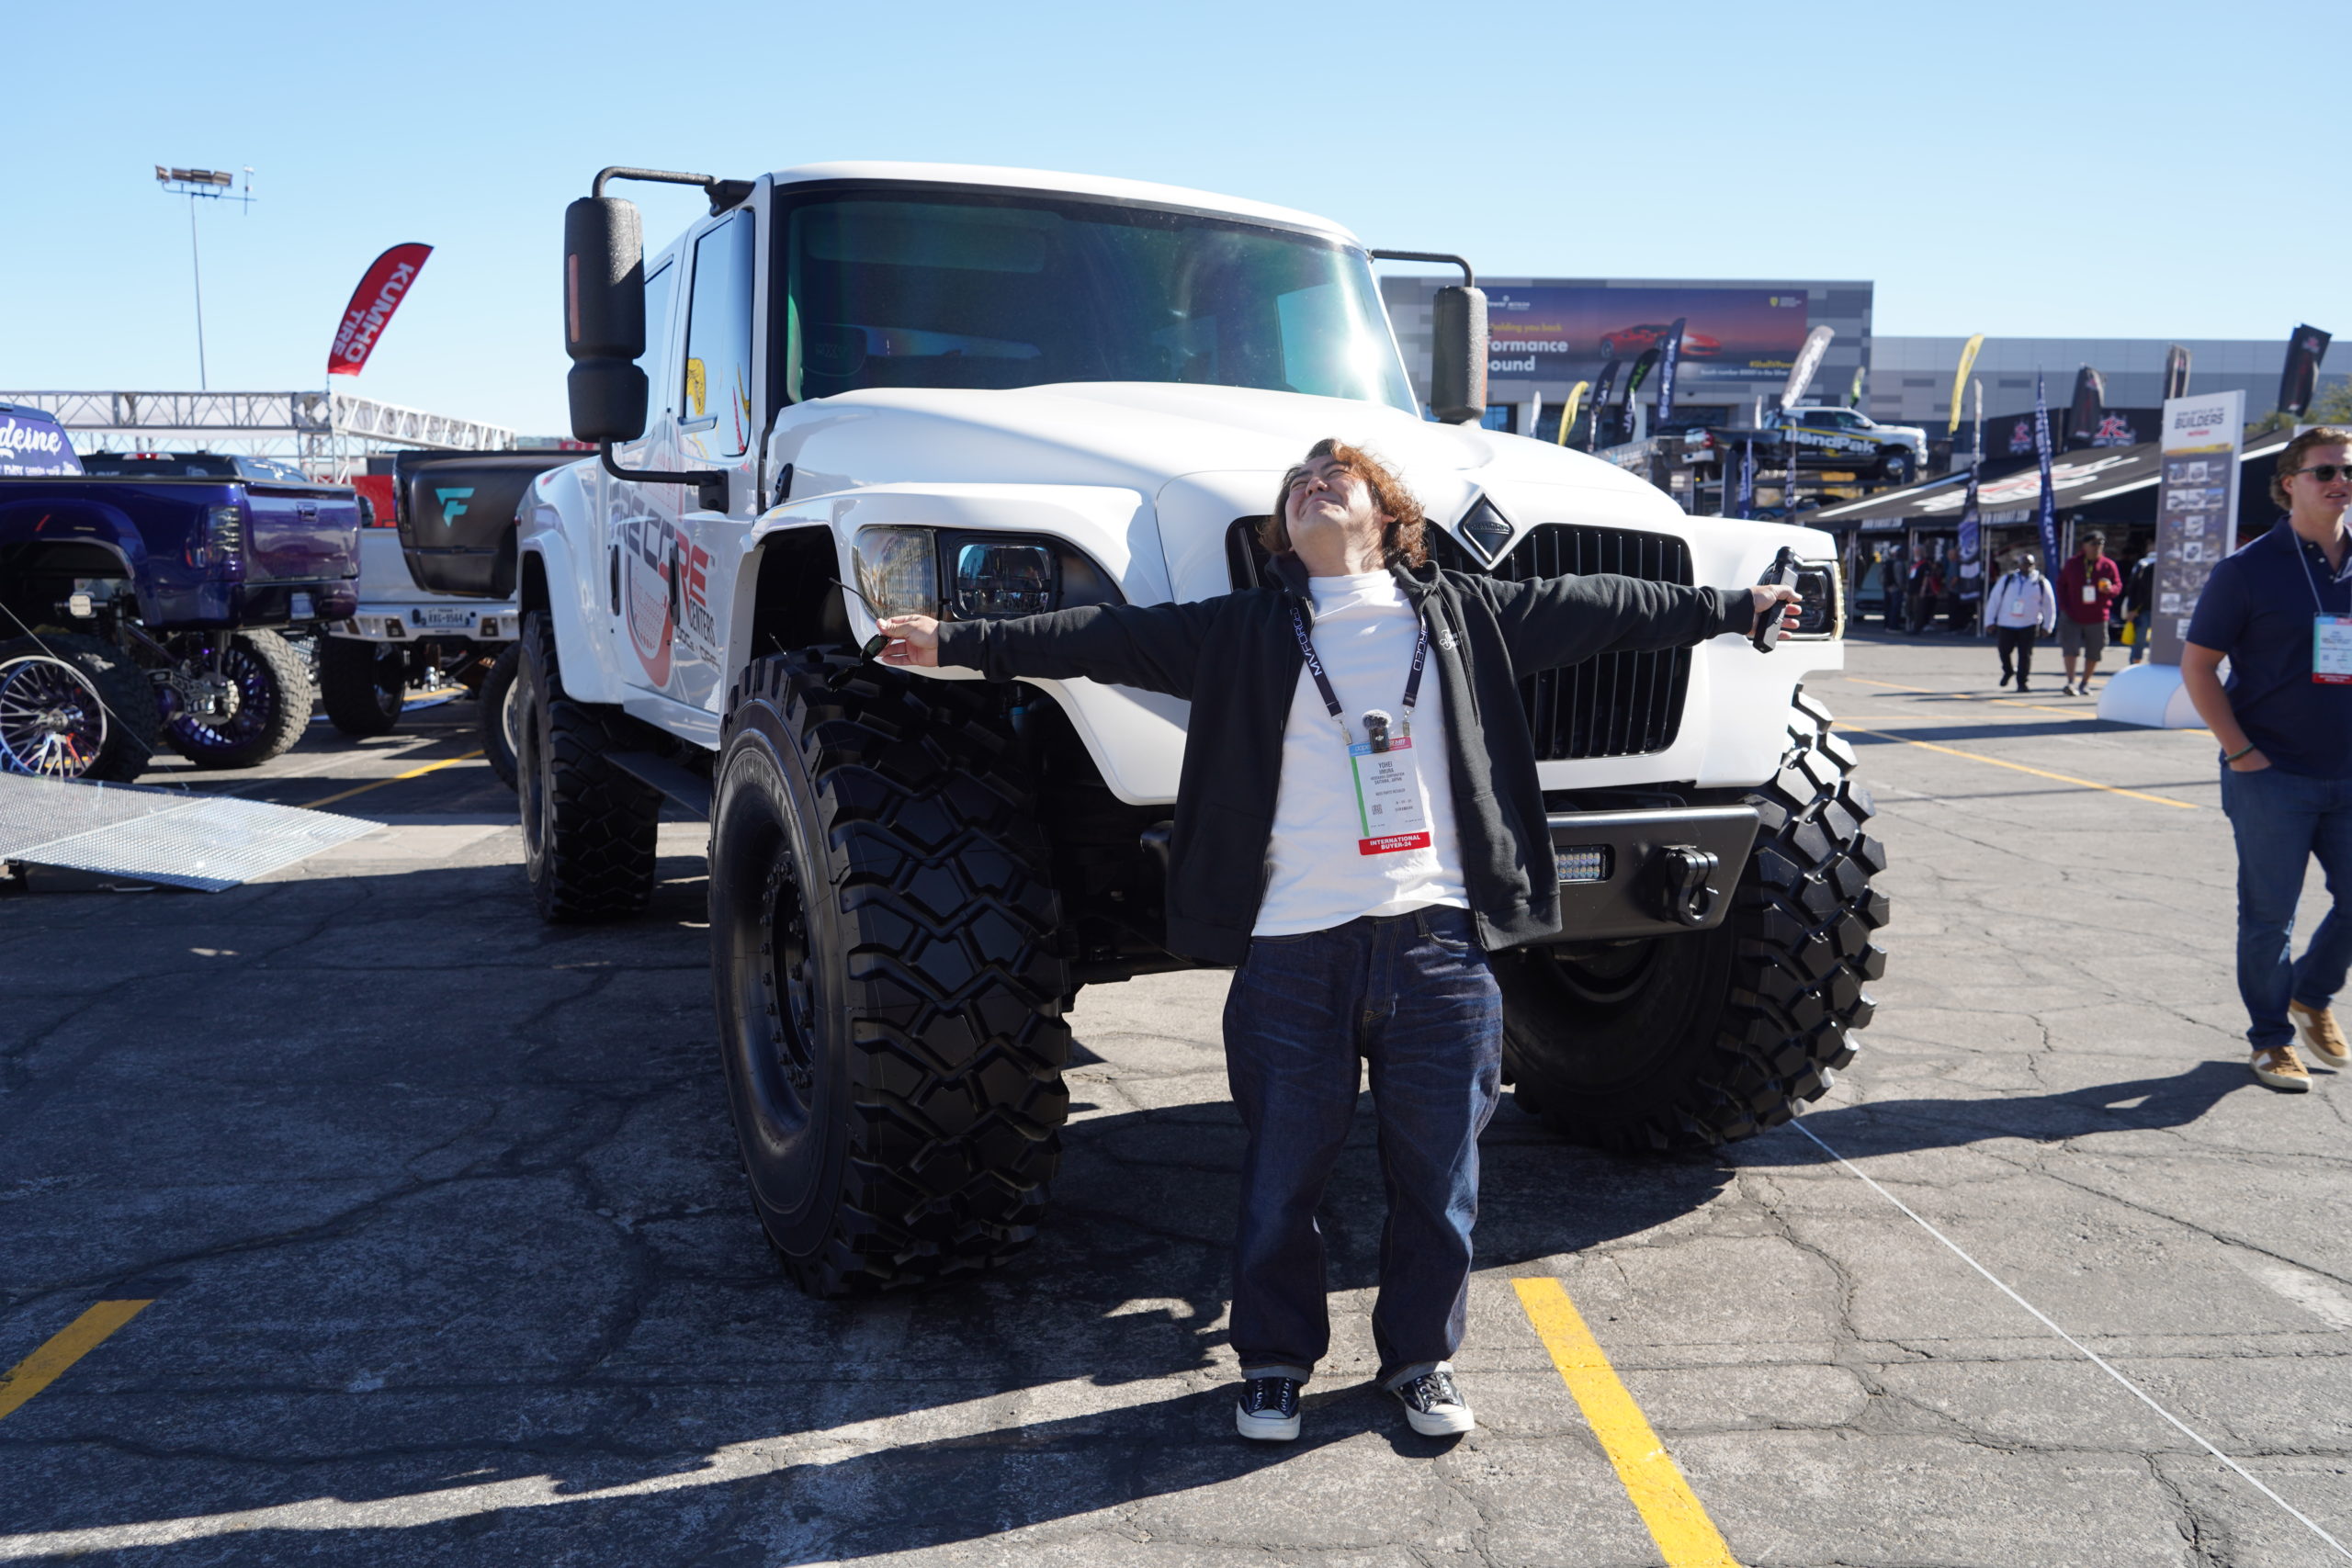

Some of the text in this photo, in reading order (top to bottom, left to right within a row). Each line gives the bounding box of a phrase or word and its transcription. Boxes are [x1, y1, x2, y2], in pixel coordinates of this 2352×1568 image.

[345, 262, 414, 363] KUMHO
[333, 310, 367, 356] TIRE
[1487, 355, 1535, 371] ound
[2175, 412, 2224, 429] BUILDERS
[1785, 428, 1876, 453] BendPak
[689, 598, 716, 648] CENTERS
[1378, 761, 1393, 769] YOHEI
[1370, 834, 1420, 846] INTERNATIONAL
[1381, 841, 1412, 851] BUYER-24
